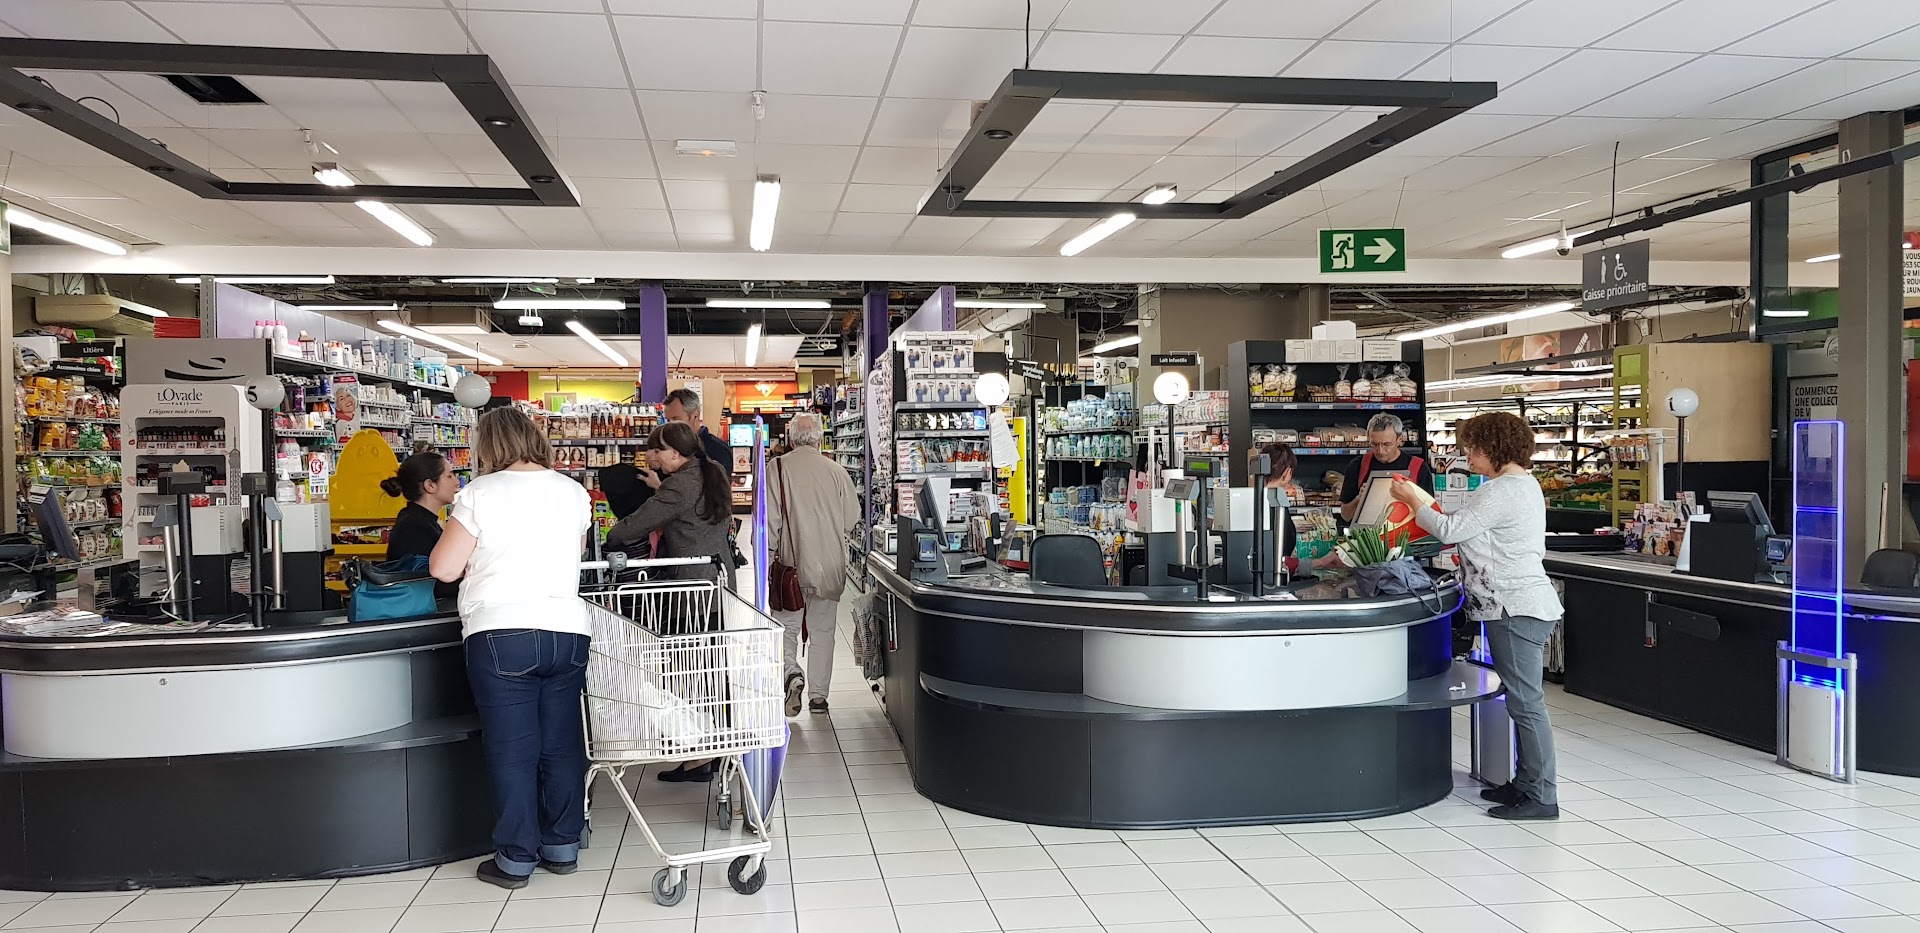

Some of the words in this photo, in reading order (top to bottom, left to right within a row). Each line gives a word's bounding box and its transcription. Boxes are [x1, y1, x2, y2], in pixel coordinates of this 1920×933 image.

[1582, 288, 1605, 301] Caisse
[1606, 280, 1647, 300] prioritaire
[247, 385, 258, 402] 5
[1795, 385, 1838, 396] COMMENCEZ
[1667, 396, 1676, 411] 1
[1794, 397, 1810, 407] UNE
[1794, 408, 1804, 417] DE
